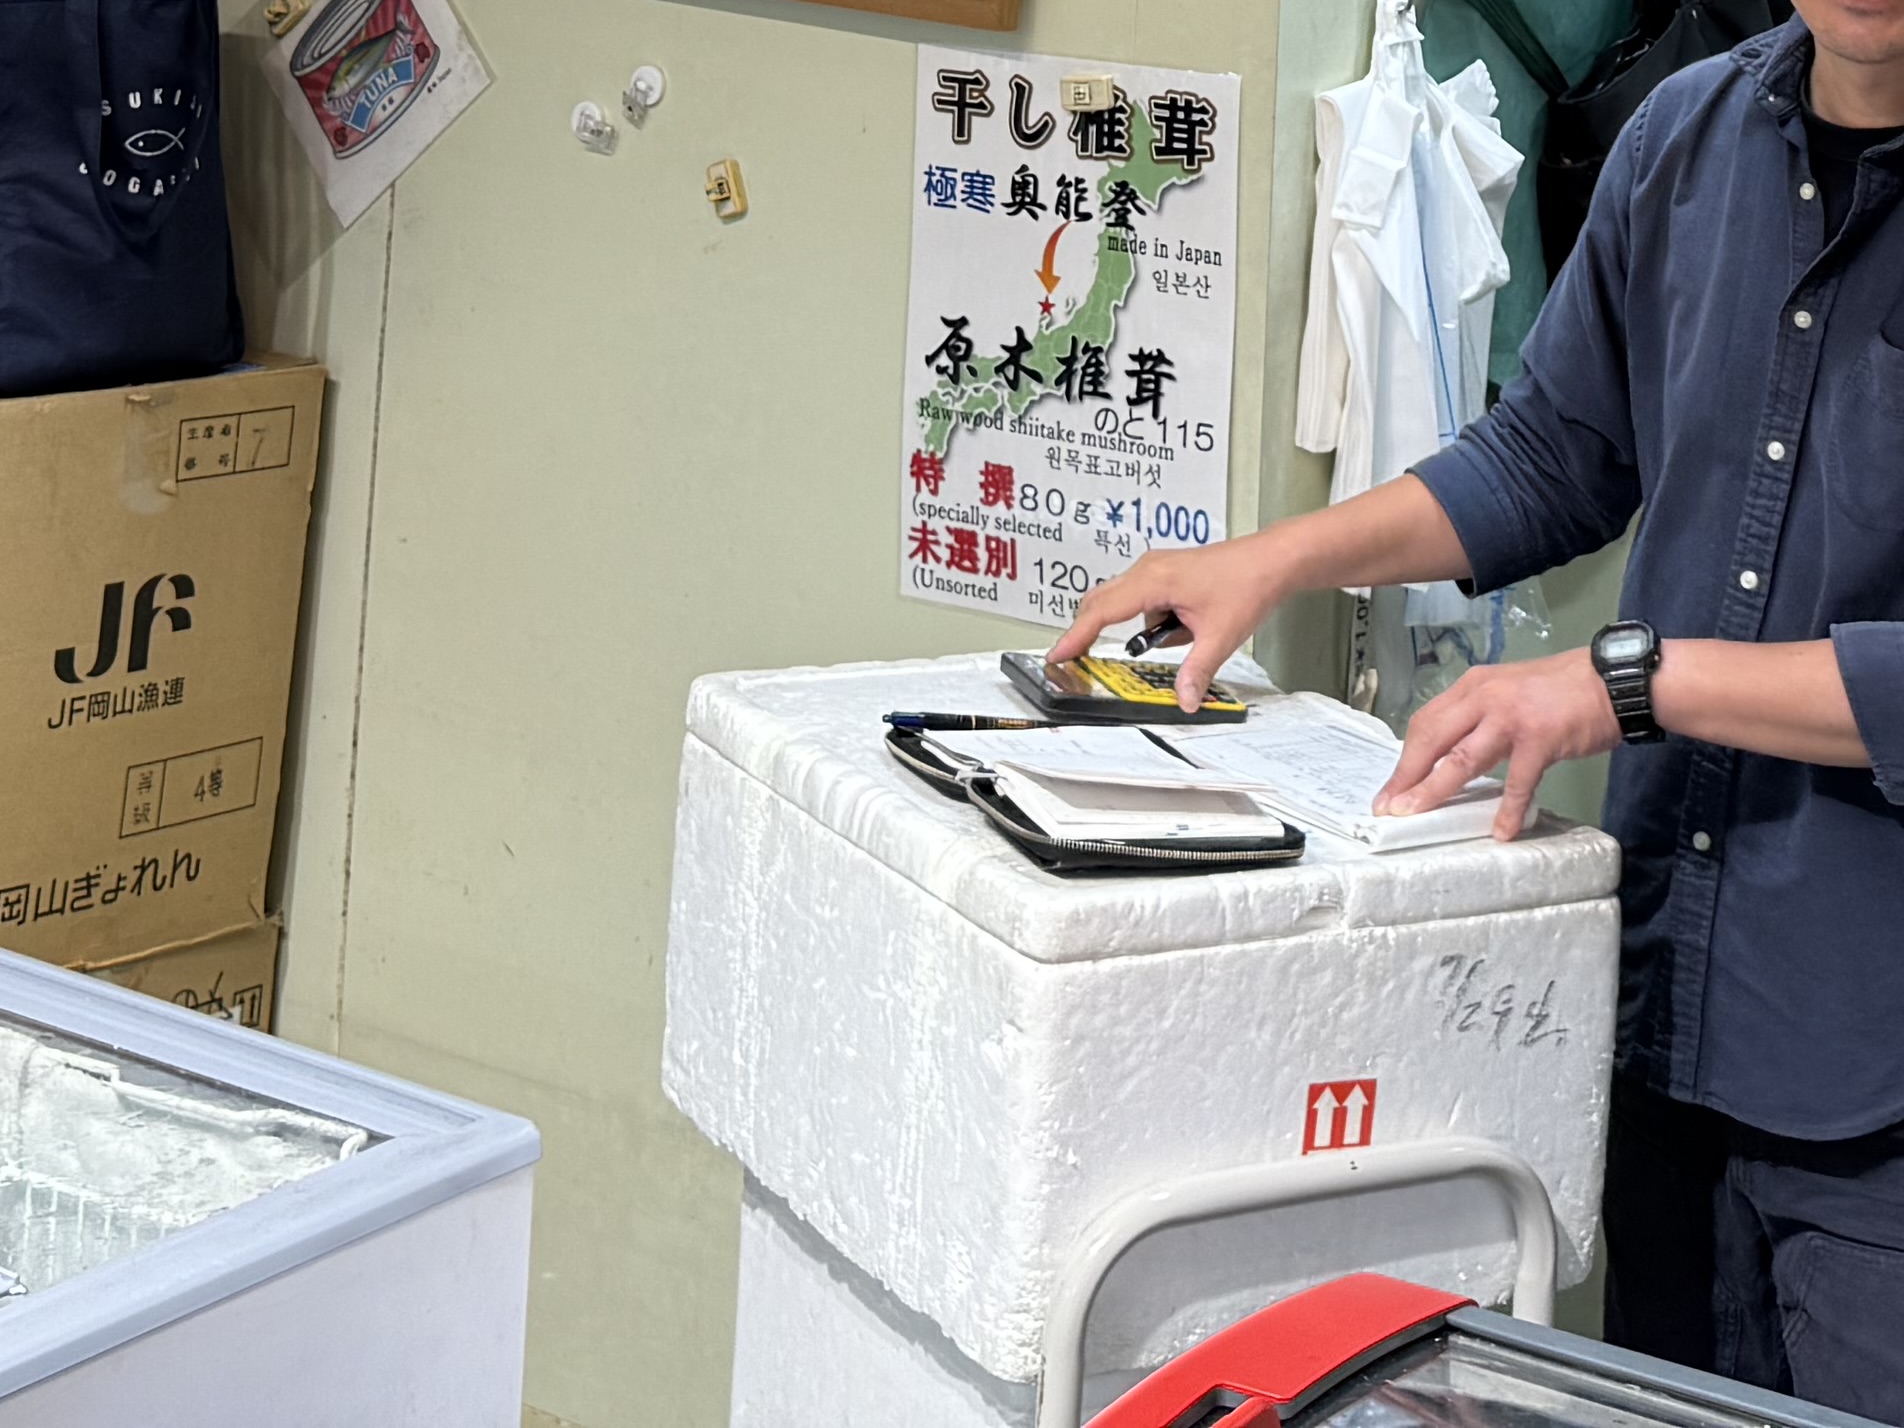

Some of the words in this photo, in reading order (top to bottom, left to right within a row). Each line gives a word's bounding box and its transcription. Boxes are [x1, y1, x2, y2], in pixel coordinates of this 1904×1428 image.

[359, 67, 398, 109] TUNA
[932, 69, 1218, 173] 干し椎茸
[923, 165, 996, 214] 極寒
[1002, 165, 1148, 233] 奥能登
[1107, 233, 1148, 255] made
[1154, 238, 1170, 260] in
[1175, 240, 1223, 267] Japan
[1152, 269, 1212, 299] 일본산
[924, 315, 1177, 421] 原木椎茸
[918, 398, 953, 422] Raw
[959, 409, 1004, 431] wood
[1010, 416, 1076, 444] shiitake
[1081, 433, 1174, 461] mushroom
[1046, 447, 1162, 489] 원목표고버섯
[995, 508, 1063, 542] selected
[1106, 497, 1210, 544] ¥1,000
[907, 520, 1018, 581] 未選別
[53, 571, 195, 685] JF
[47, 676, 186, 732] JF岡山漁連
